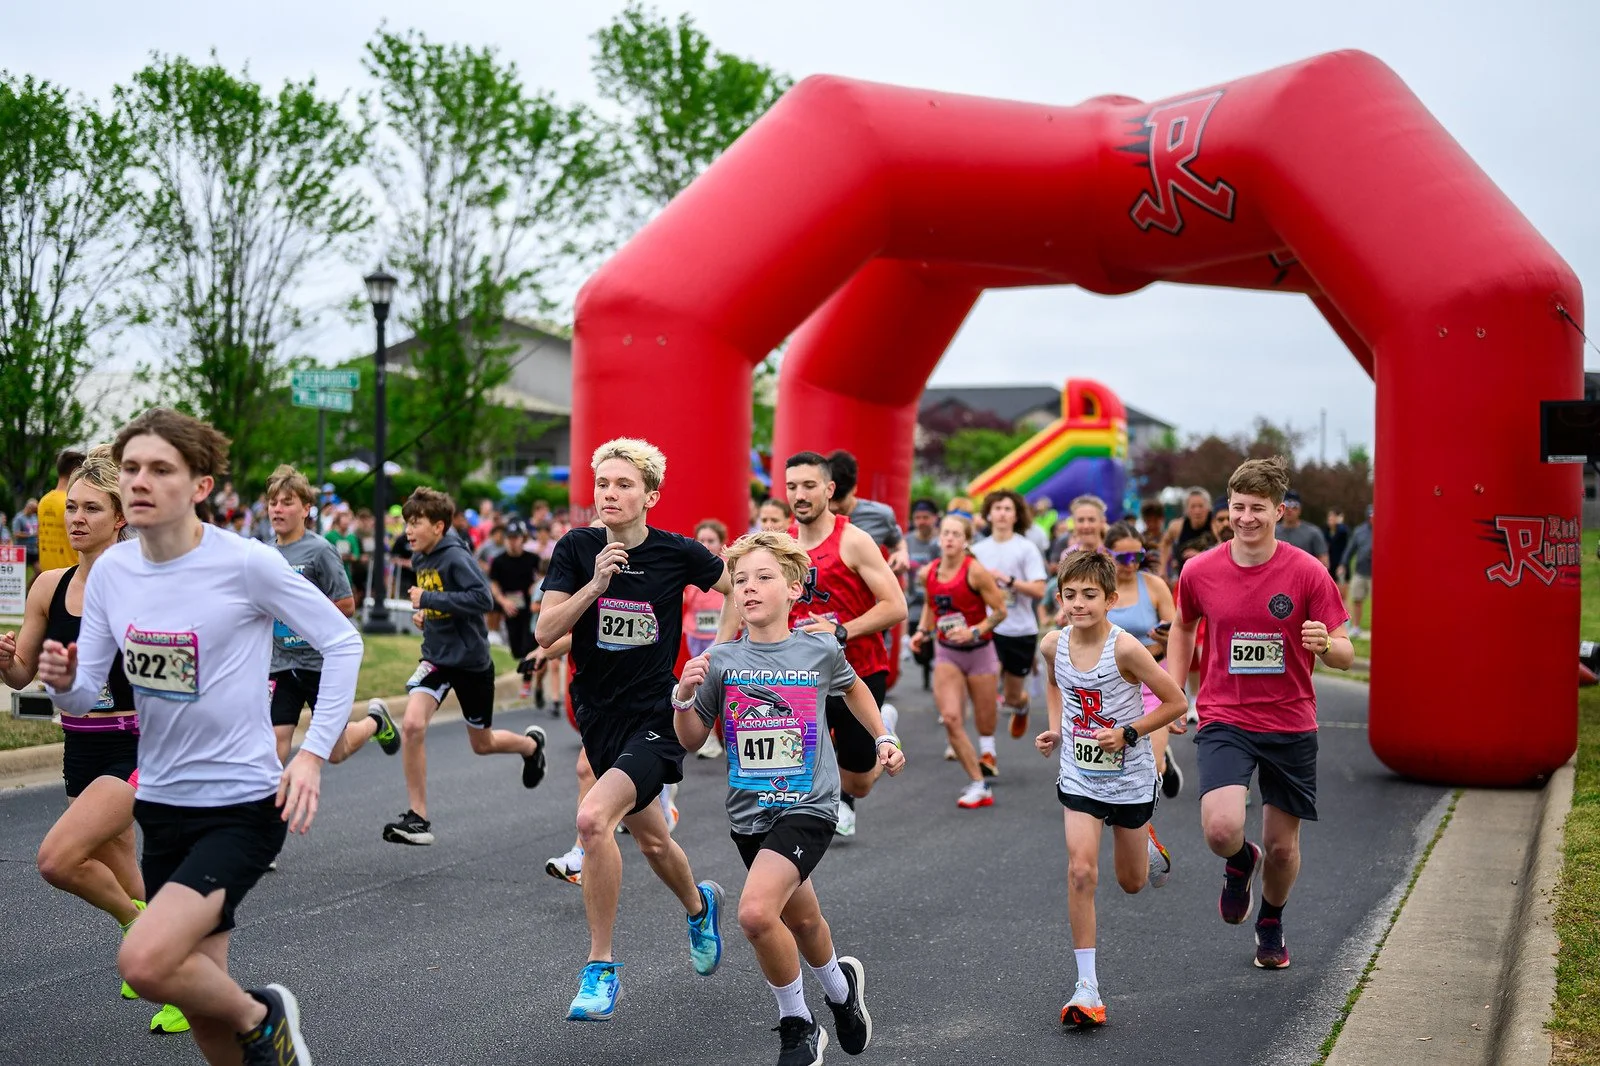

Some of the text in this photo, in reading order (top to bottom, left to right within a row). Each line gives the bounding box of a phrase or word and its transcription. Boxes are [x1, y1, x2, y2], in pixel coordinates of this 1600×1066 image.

[601, 600, 647, 611] JACKRABBIT
[602, 615, 634, 637] 321
[1233, 645, 1265, 661] 520
[126, 649, 167, 680] 322
[722, 669, 820, 687] JACKRABBIT
[736, 717, 799, 729] JACKRABBIT 5K
[743, 737, 775, 761] 417
[1075, 742, 1104, 764] 382
